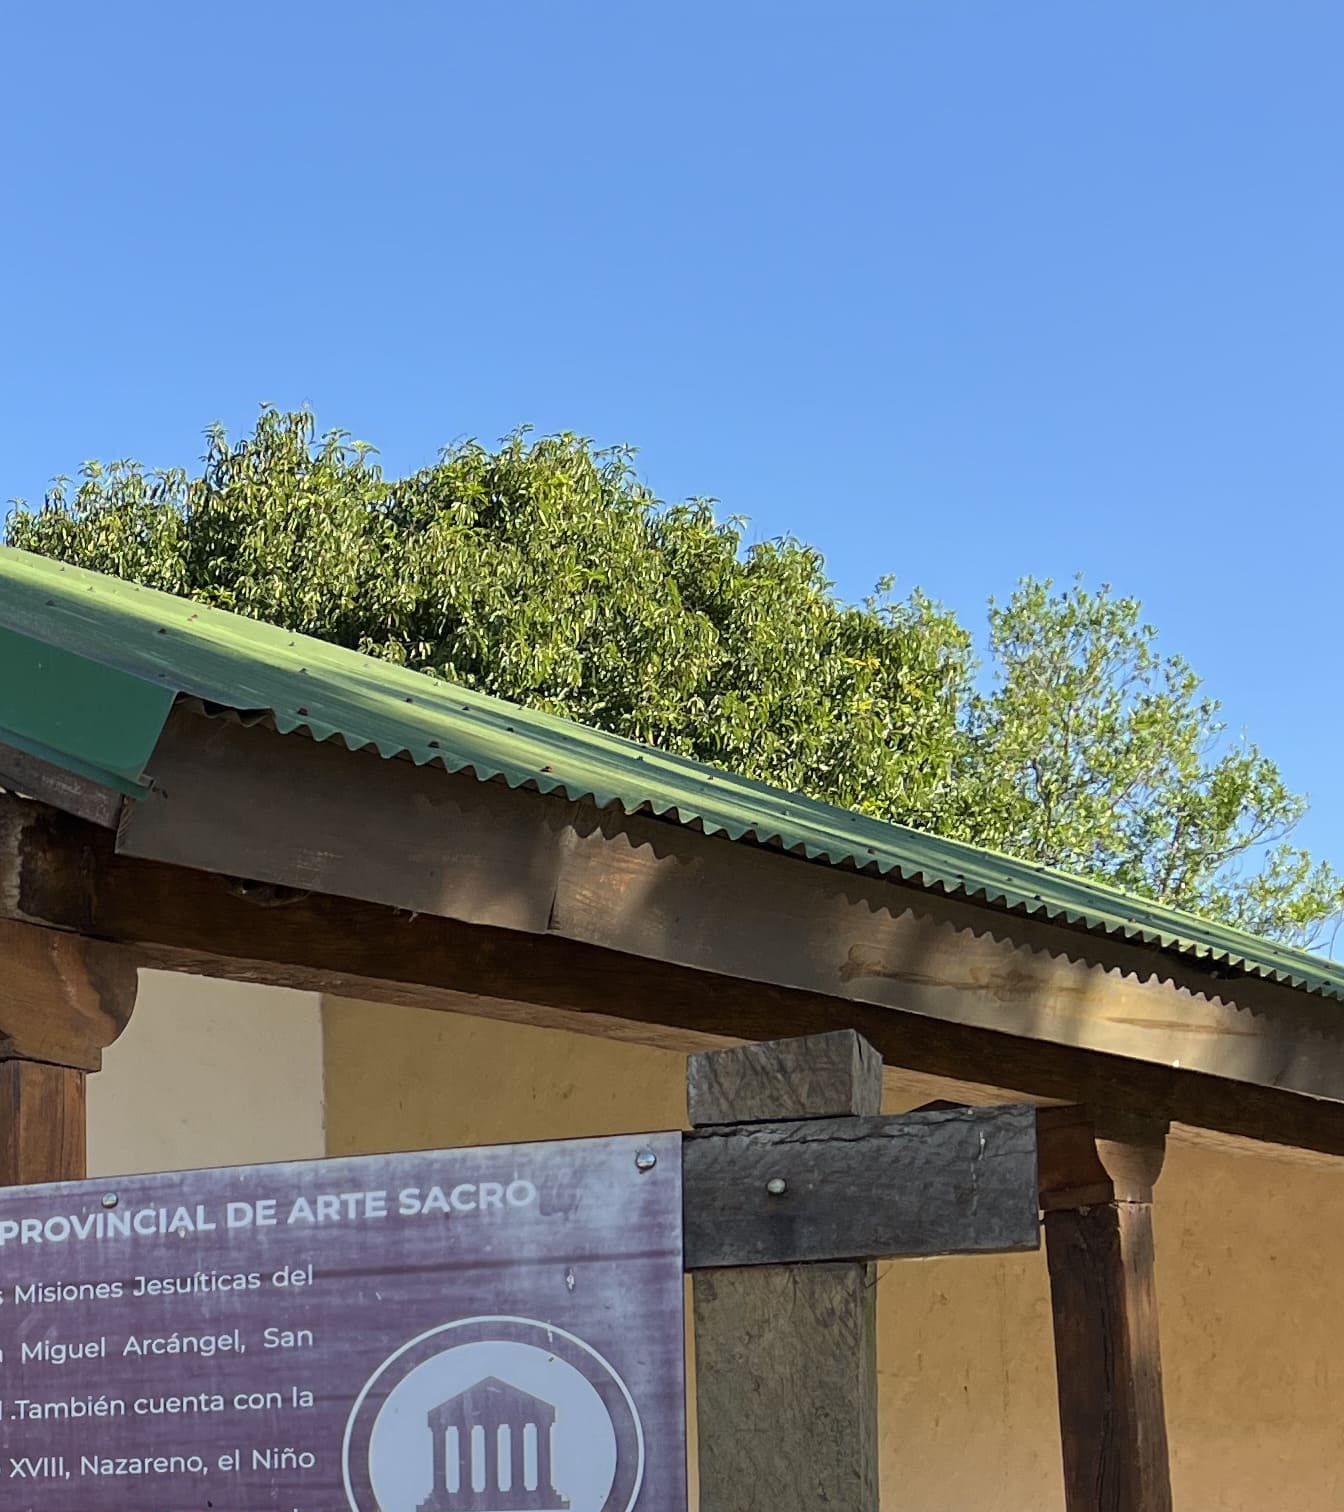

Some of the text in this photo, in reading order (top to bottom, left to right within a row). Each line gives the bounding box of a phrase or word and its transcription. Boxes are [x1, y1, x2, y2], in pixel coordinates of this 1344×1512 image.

[227, 1198, 277, 1229] DE
[288, 1190, 387, 1224] ARTE
[399, 1180, 535, 1215] SACRO
[15, 1280, 123, 1305] Misiones
[133, 1270, 261, 1297] Jesuíticas
[272, 1263, 312, 1288] del
[22, 1336, 105, 1365] Miguel
[123, 1328, 245, 1357] Arcángel,
[264, 1327, 313, 1349] San
[134, 1392, 224, 1415] cuenta
[234, 1392, 282, 1411] con
[293, 1385, 313, 1408] la
[10, 1456, 70, 1480] XVIII,
[81, 1455, 208, 1476] Nazareno,
[218, 1448, 239, 1472] el
[253, 1447, 315, 1471] Niño
